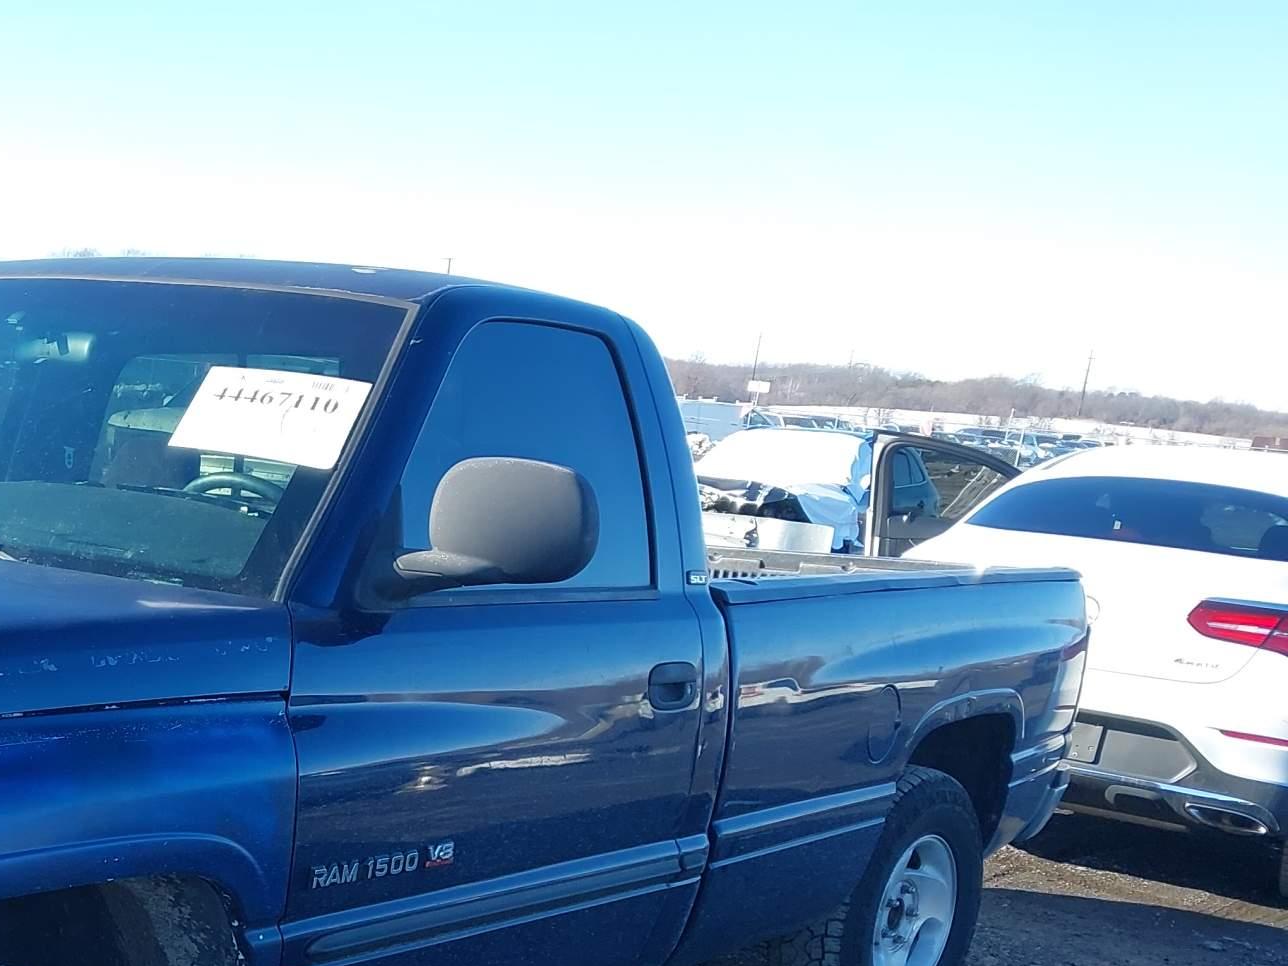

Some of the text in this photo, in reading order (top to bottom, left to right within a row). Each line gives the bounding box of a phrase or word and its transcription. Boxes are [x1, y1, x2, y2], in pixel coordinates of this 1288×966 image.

[214, 387, 339, 414] 44467110
[690, 575, 707, 584] SLT
[312, 841, 455, 889] RAM 1500 V8
